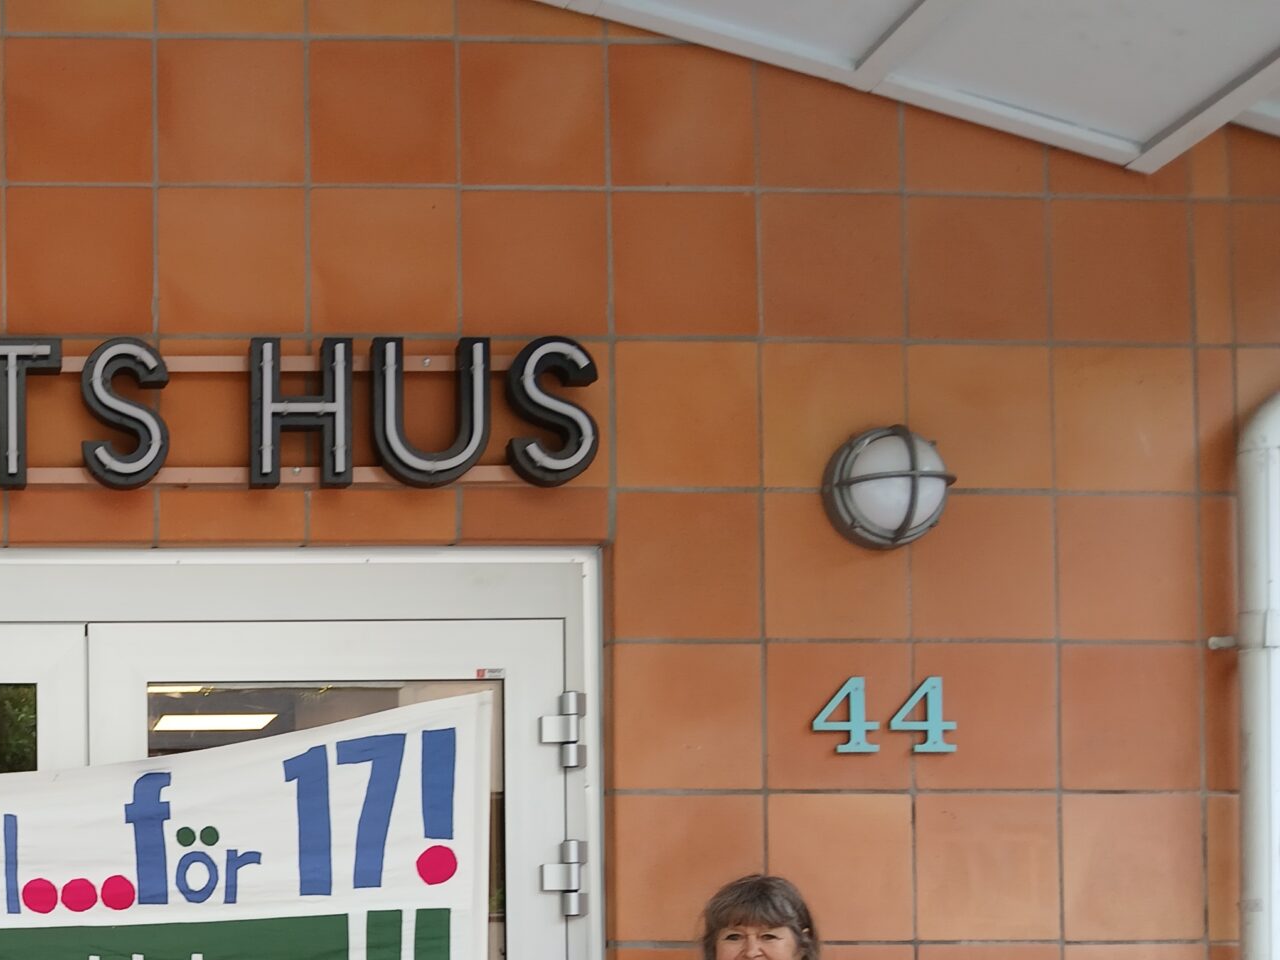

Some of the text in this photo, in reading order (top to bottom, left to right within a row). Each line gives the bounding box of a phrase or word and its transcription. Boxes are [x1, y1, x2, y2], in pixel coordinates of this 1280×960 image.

[248, 334, 600, 489] HUS
[811, 676, 958, 753] 44
[283, 727, 459, 896] 17!
